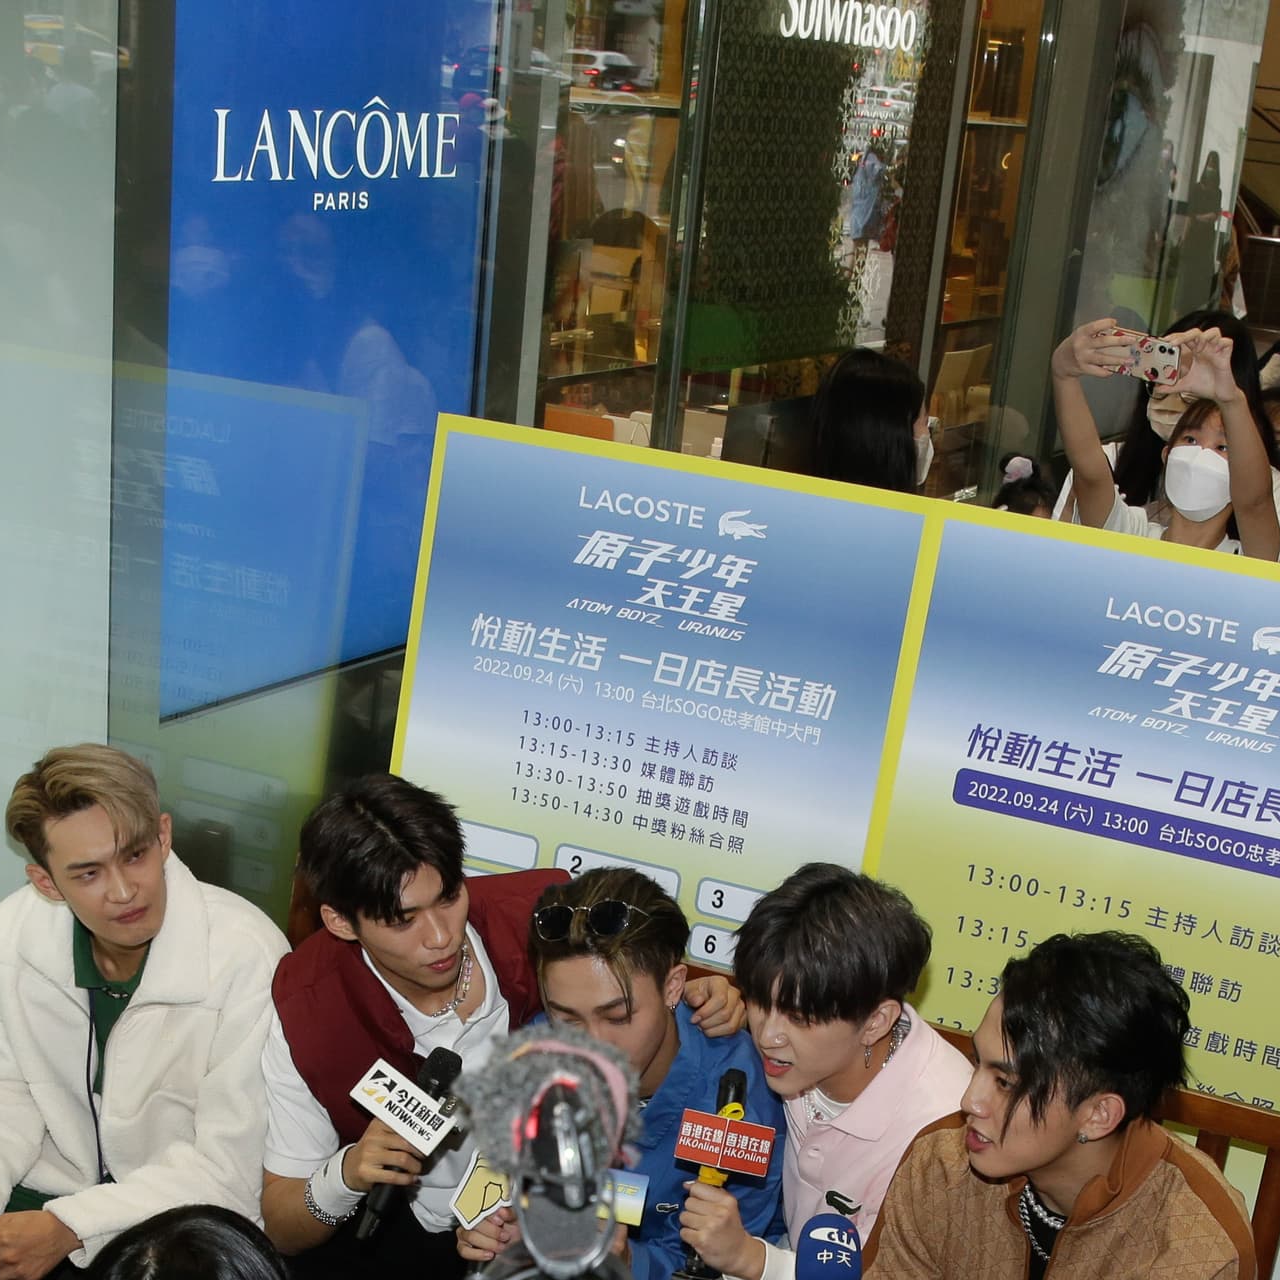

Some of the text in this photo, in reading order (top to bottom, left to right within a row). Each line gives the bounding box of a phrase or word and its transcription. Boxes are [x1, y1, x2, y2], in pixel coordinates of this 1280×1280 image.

[211, 95, 460, 182] LANCÔME
[313, 191, 370, 211] PARIS
[578, 485, 706, 529] LACOSTE
[573, 529, 759, 588] 原子少年
[566, 597, 613, 616] ATOM
[678, 619, 746, 642] URANUS
[626, 577, 749, 626] 天王星
[1105, 596, 1240, 644] LACOSTE
[471, 612, 838, 721] 悅動生活 一日店長活動
[473, 655, 554, 687] 2022.09.24
[558, 673, 584, 696] (六)
[594, 681, 635, 703] 13:00
[1087, 706, 1138, 725] ATOM
[1205, 730, 1277, 754] URANUS
[1151, 688, 1280, 739] 天王星
[518, 735, 715, 794] 13:15-13:30 媒體聯訪
[521, 709, 739, 772] 13:00-13:15 主持人訪談
[966, 722, 1123, 789] 悅動生活
[511, 786, 624, 826] 13:50-14:30
[514, 760, 750, 829] 13:30-13:50 抽獎遊戲時間
[967, 781, 1060, 816] 2022.09.24
[1063, 801, 1094, 827] (六)
[1101, 811, 1150, 837] 13:00
[569, 855, 583, 875] 2
[711, 888, 725, 910] 3
[967, 863, 1133, 919] 13:00-13:15
[704, 933, 717, 955] 6
[1161, 963, 1243, 1004] 體聯訪
[395, 1088, 446, 1132] 今日新聞
[678, 1136, 721, 1156] HKOnline
[723, 1147, 768, 1166] HKOnline
[816, 1248, 852, 1268] 中天
